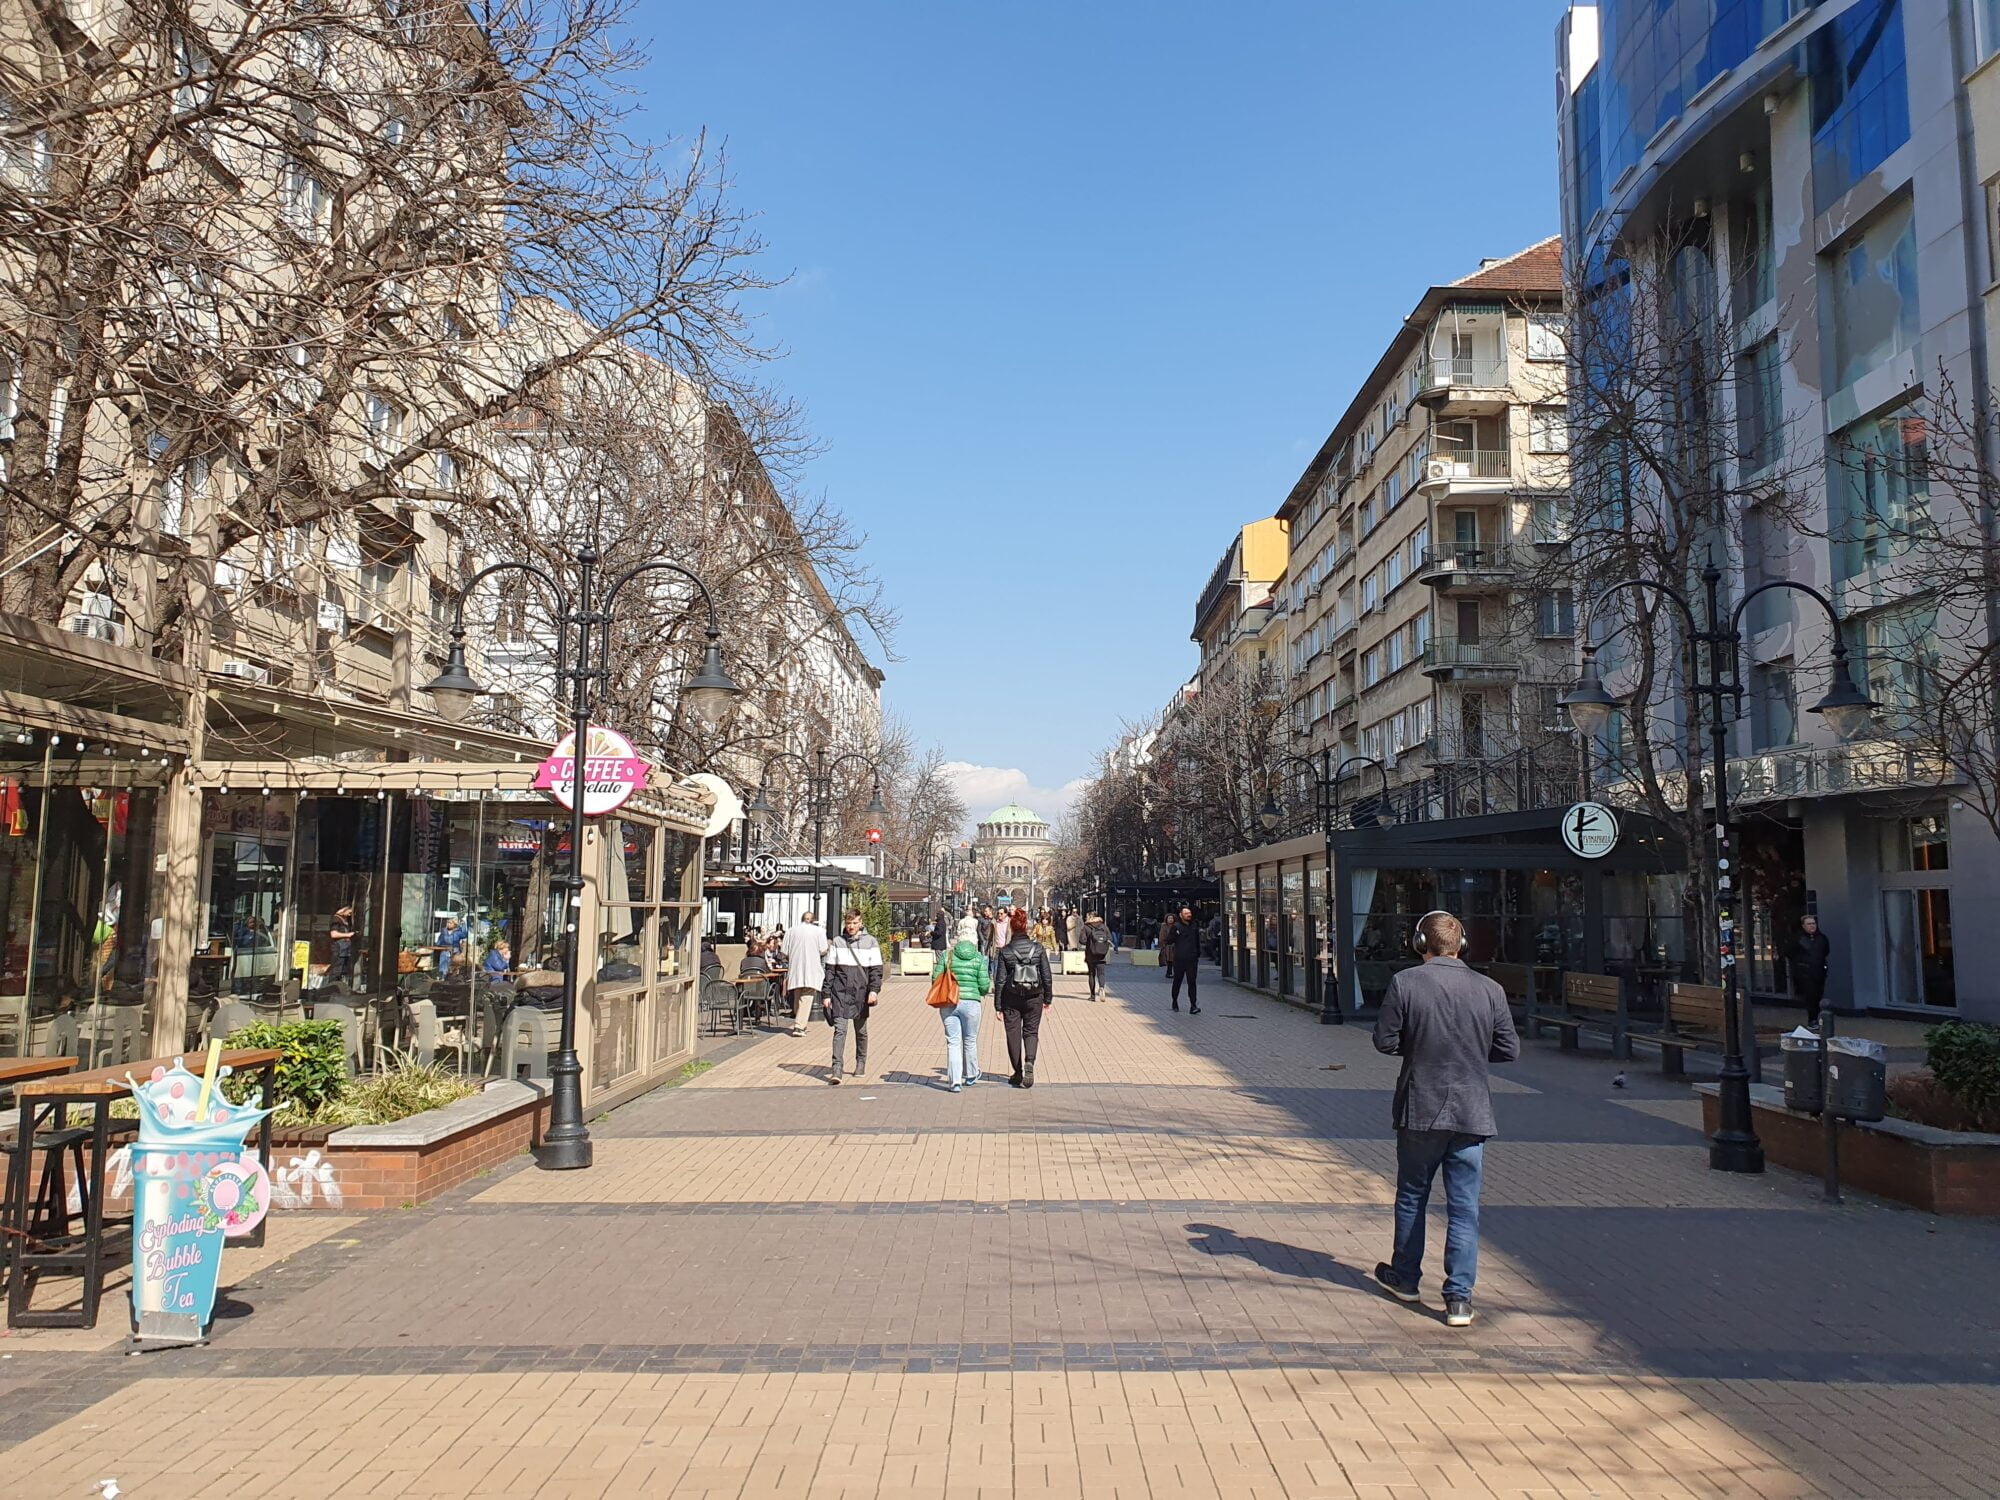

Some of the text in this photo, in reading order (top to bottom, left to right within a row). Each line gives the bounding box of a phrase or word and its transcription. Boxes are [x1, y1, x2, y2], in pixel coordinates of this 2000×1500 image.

[560, 759, 624, 780] CFFEE
[584, 781, 622, 793] elato
[138, 1213, 217, 1252] Exploding
[147, 1242, 202, 1281] Bubble
[161, 1271, 195, 1310] Tea
